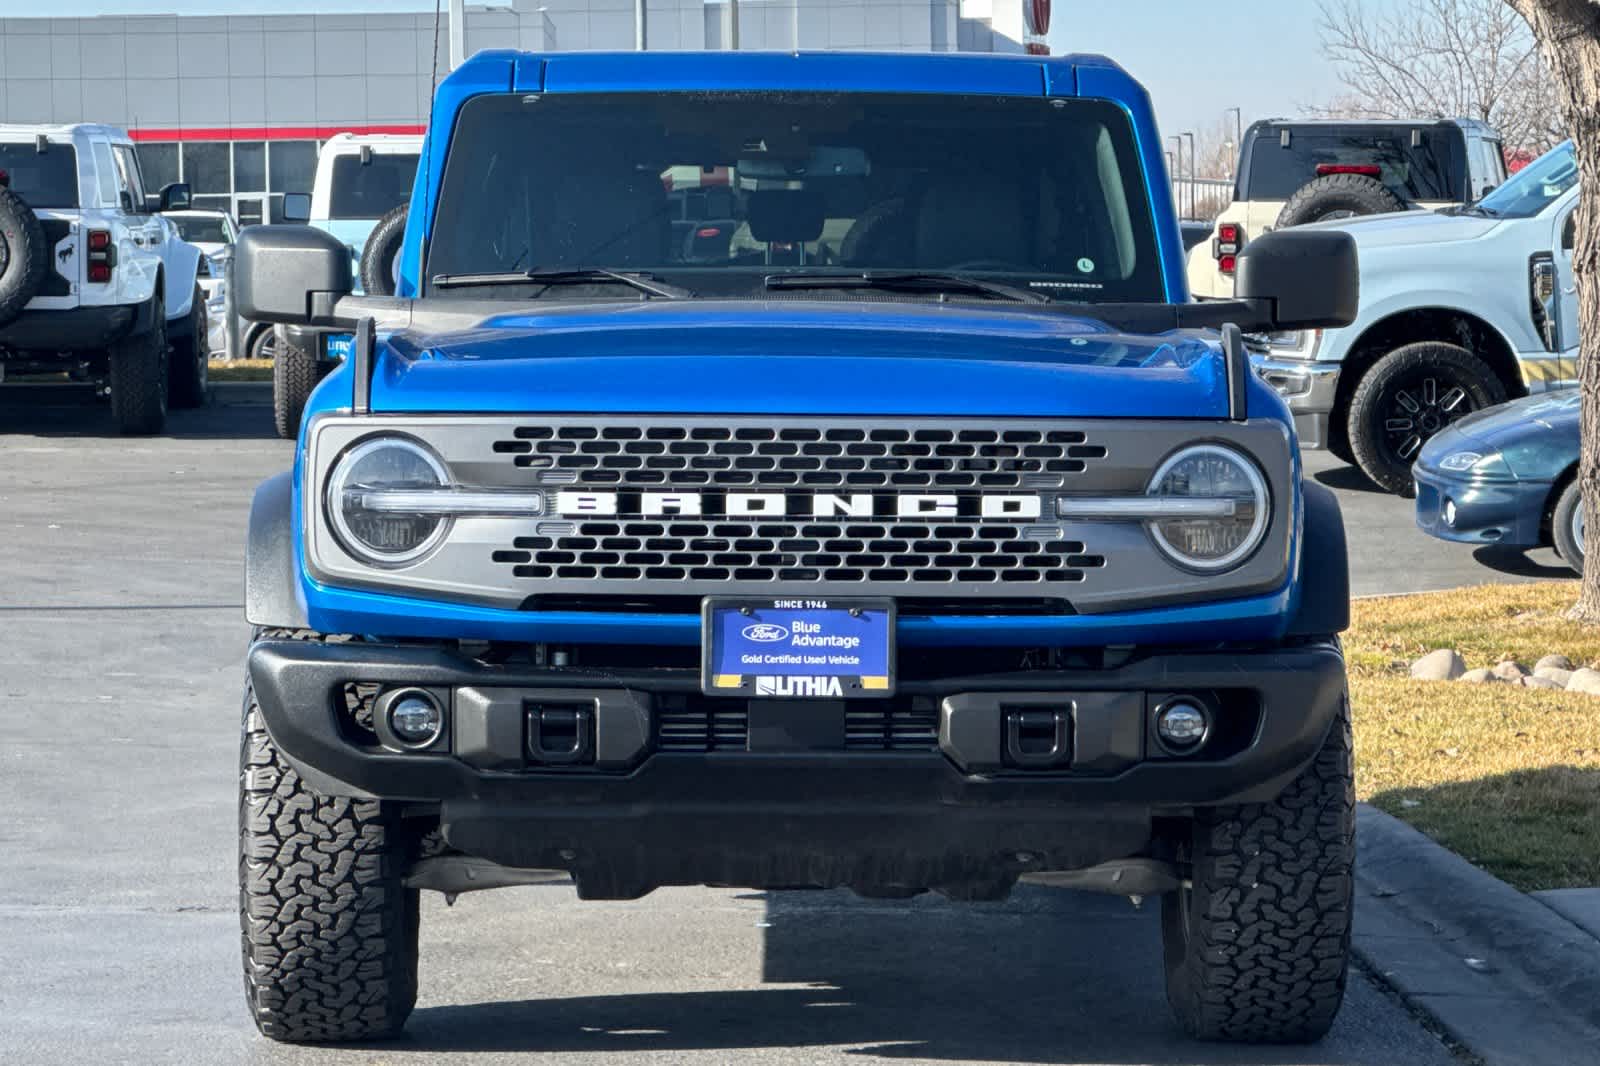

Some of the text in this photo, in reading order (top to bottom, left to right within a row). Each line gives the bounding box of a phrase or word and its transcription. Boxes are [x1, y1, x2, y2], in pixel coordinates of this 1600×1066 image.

[557, 491, 1041, 518] BRONCO
[773, 600, 827, 609] SINCE 1946
[750, 625, 780, 640] Ford
[791, 620, 821, 634] Blue
[791, 634, 860, 648] Advantage
[741, 654, 860, 665] Gold Certified Used Vehicle
[775, 675, 843, 696] LITHIA
